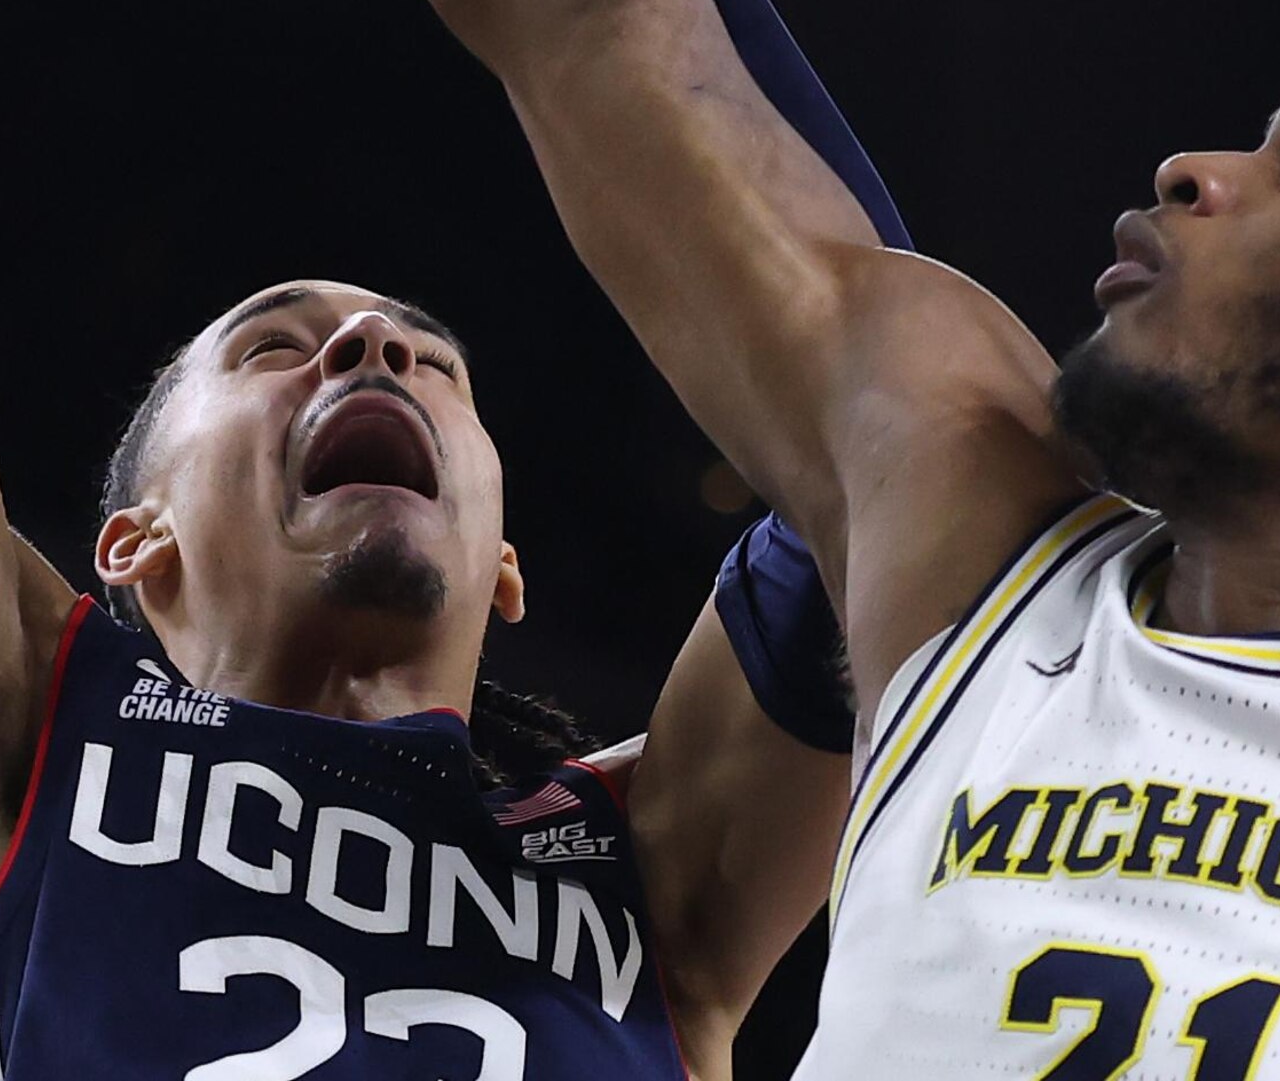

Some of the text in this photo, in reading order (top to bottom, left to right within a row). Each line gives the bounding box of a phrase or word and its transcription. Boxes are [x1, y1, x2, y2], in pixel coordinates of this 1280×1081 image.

[132, 678, 169, 696] BE
[119, 695, 230, 727] CHANGE
[522, 821, 587, 847] BIG
[522, 836, 616, 860] EAST
[69, 742, 643, 1023] UCONN
